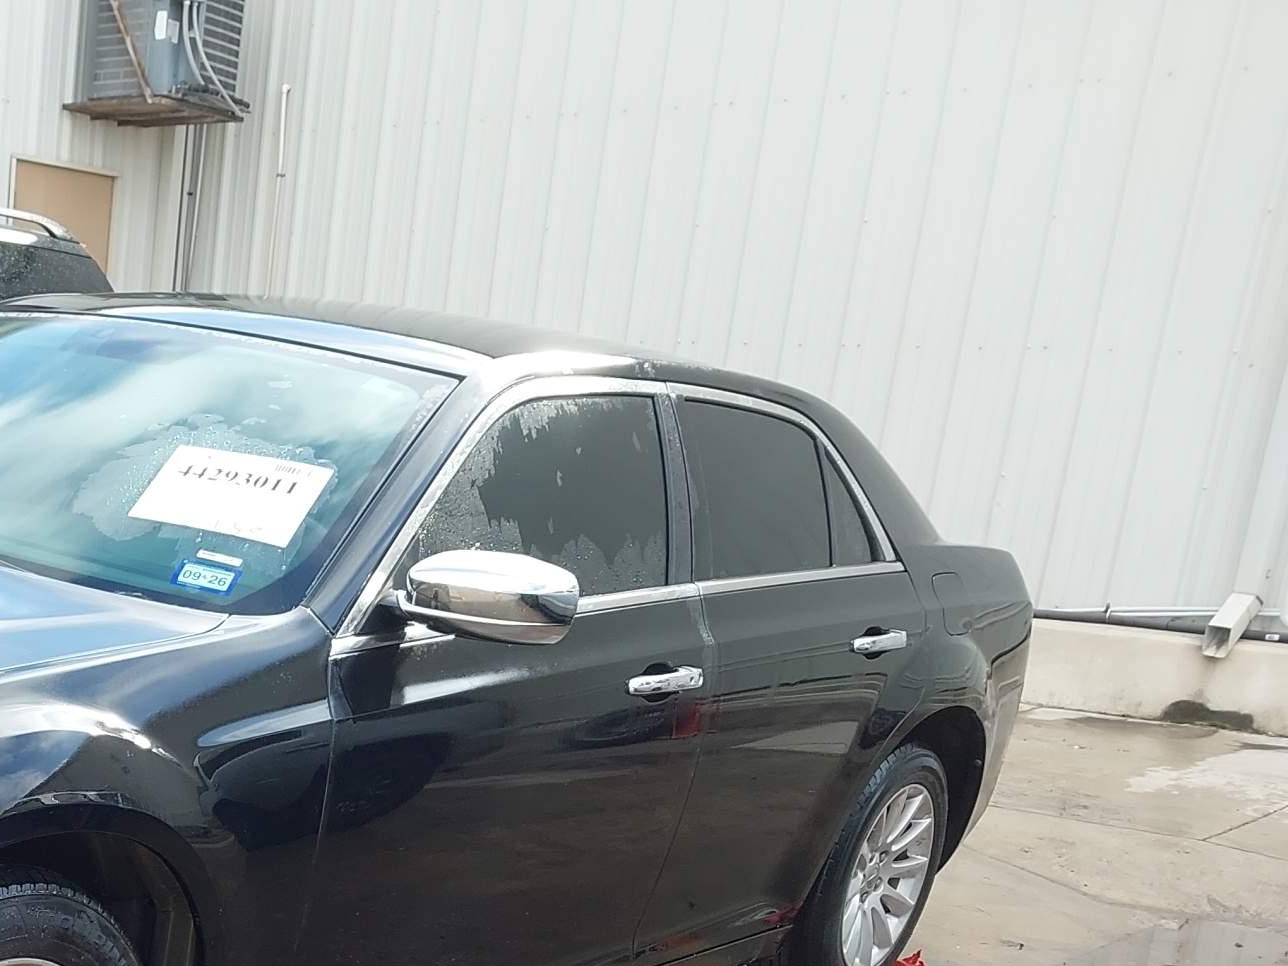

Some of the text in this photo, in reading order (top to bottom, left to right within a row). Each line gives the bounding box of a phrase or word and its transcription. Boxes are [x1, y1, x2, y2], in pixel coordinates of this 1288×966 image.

[178, 463, 299, 495] 44293011
[182, 569, 202, 581] 09
[207, 575, 228, 587] 26
